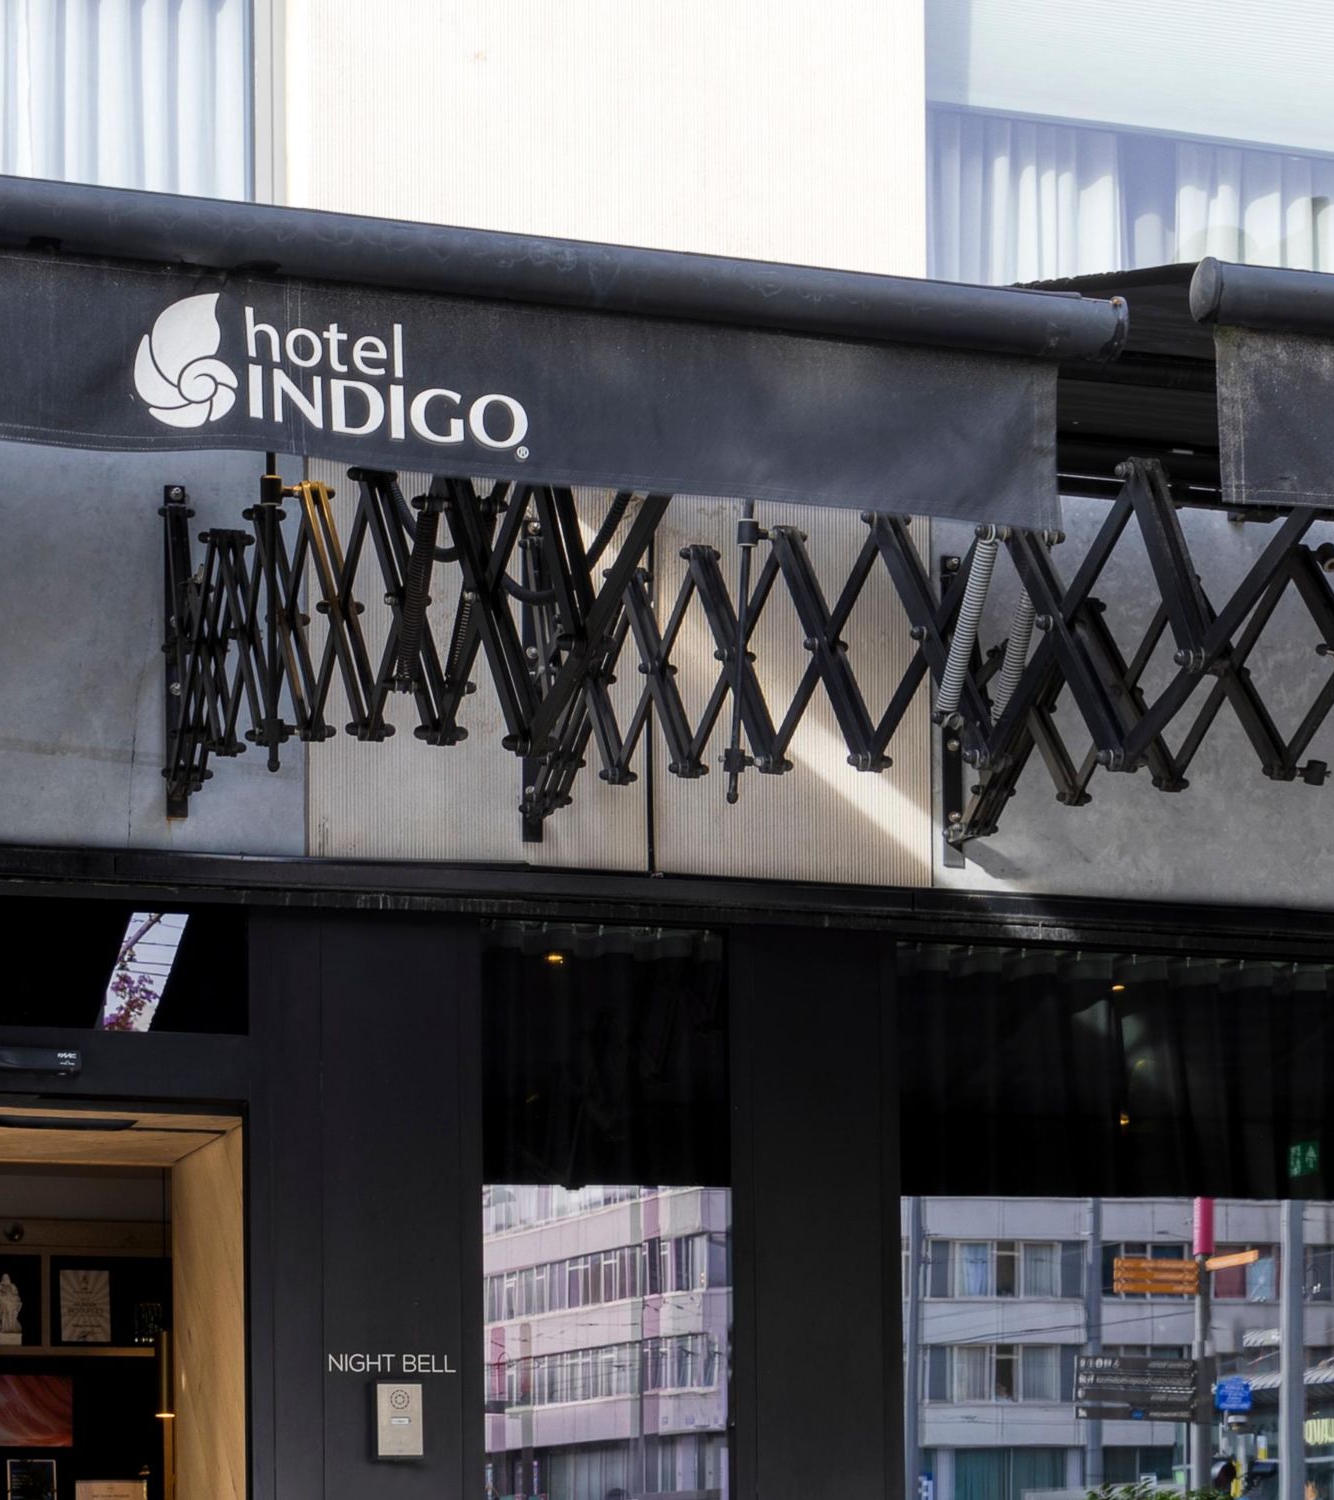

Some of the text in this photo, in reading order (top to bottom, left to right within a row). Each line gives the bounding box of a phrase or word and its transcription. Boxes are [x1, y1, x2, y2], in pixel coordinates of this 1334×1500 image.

[244, 306, 402, 378] hotel
[247, 363, 529, 449] INDIGO
[328, 1353, 456, 1373] NIGHT BELL
